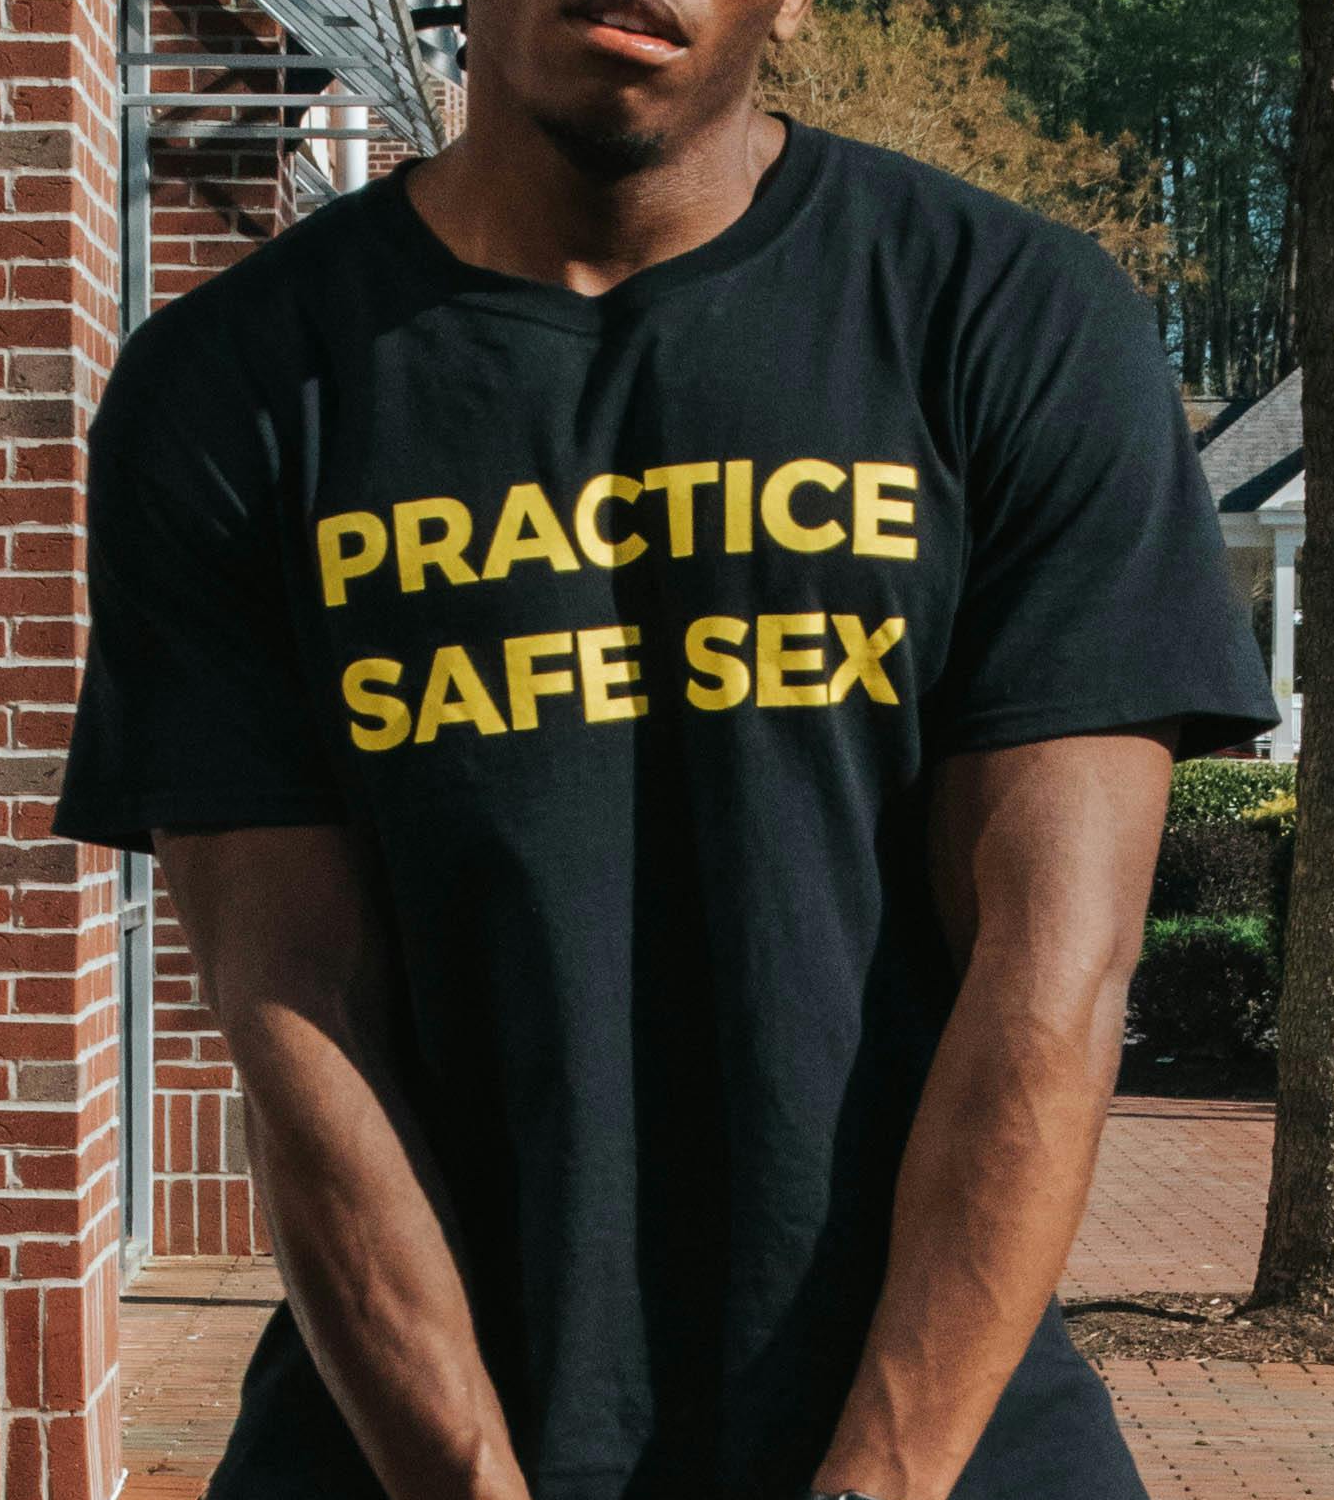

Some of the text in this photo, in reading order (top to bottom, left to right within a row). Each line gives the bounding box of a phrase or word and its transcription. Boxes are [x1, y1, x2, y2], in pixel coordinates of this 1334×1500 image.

[316, 458, 918, 607] PRACTICE
[341, 611, 906, 752] SAFE SEX
